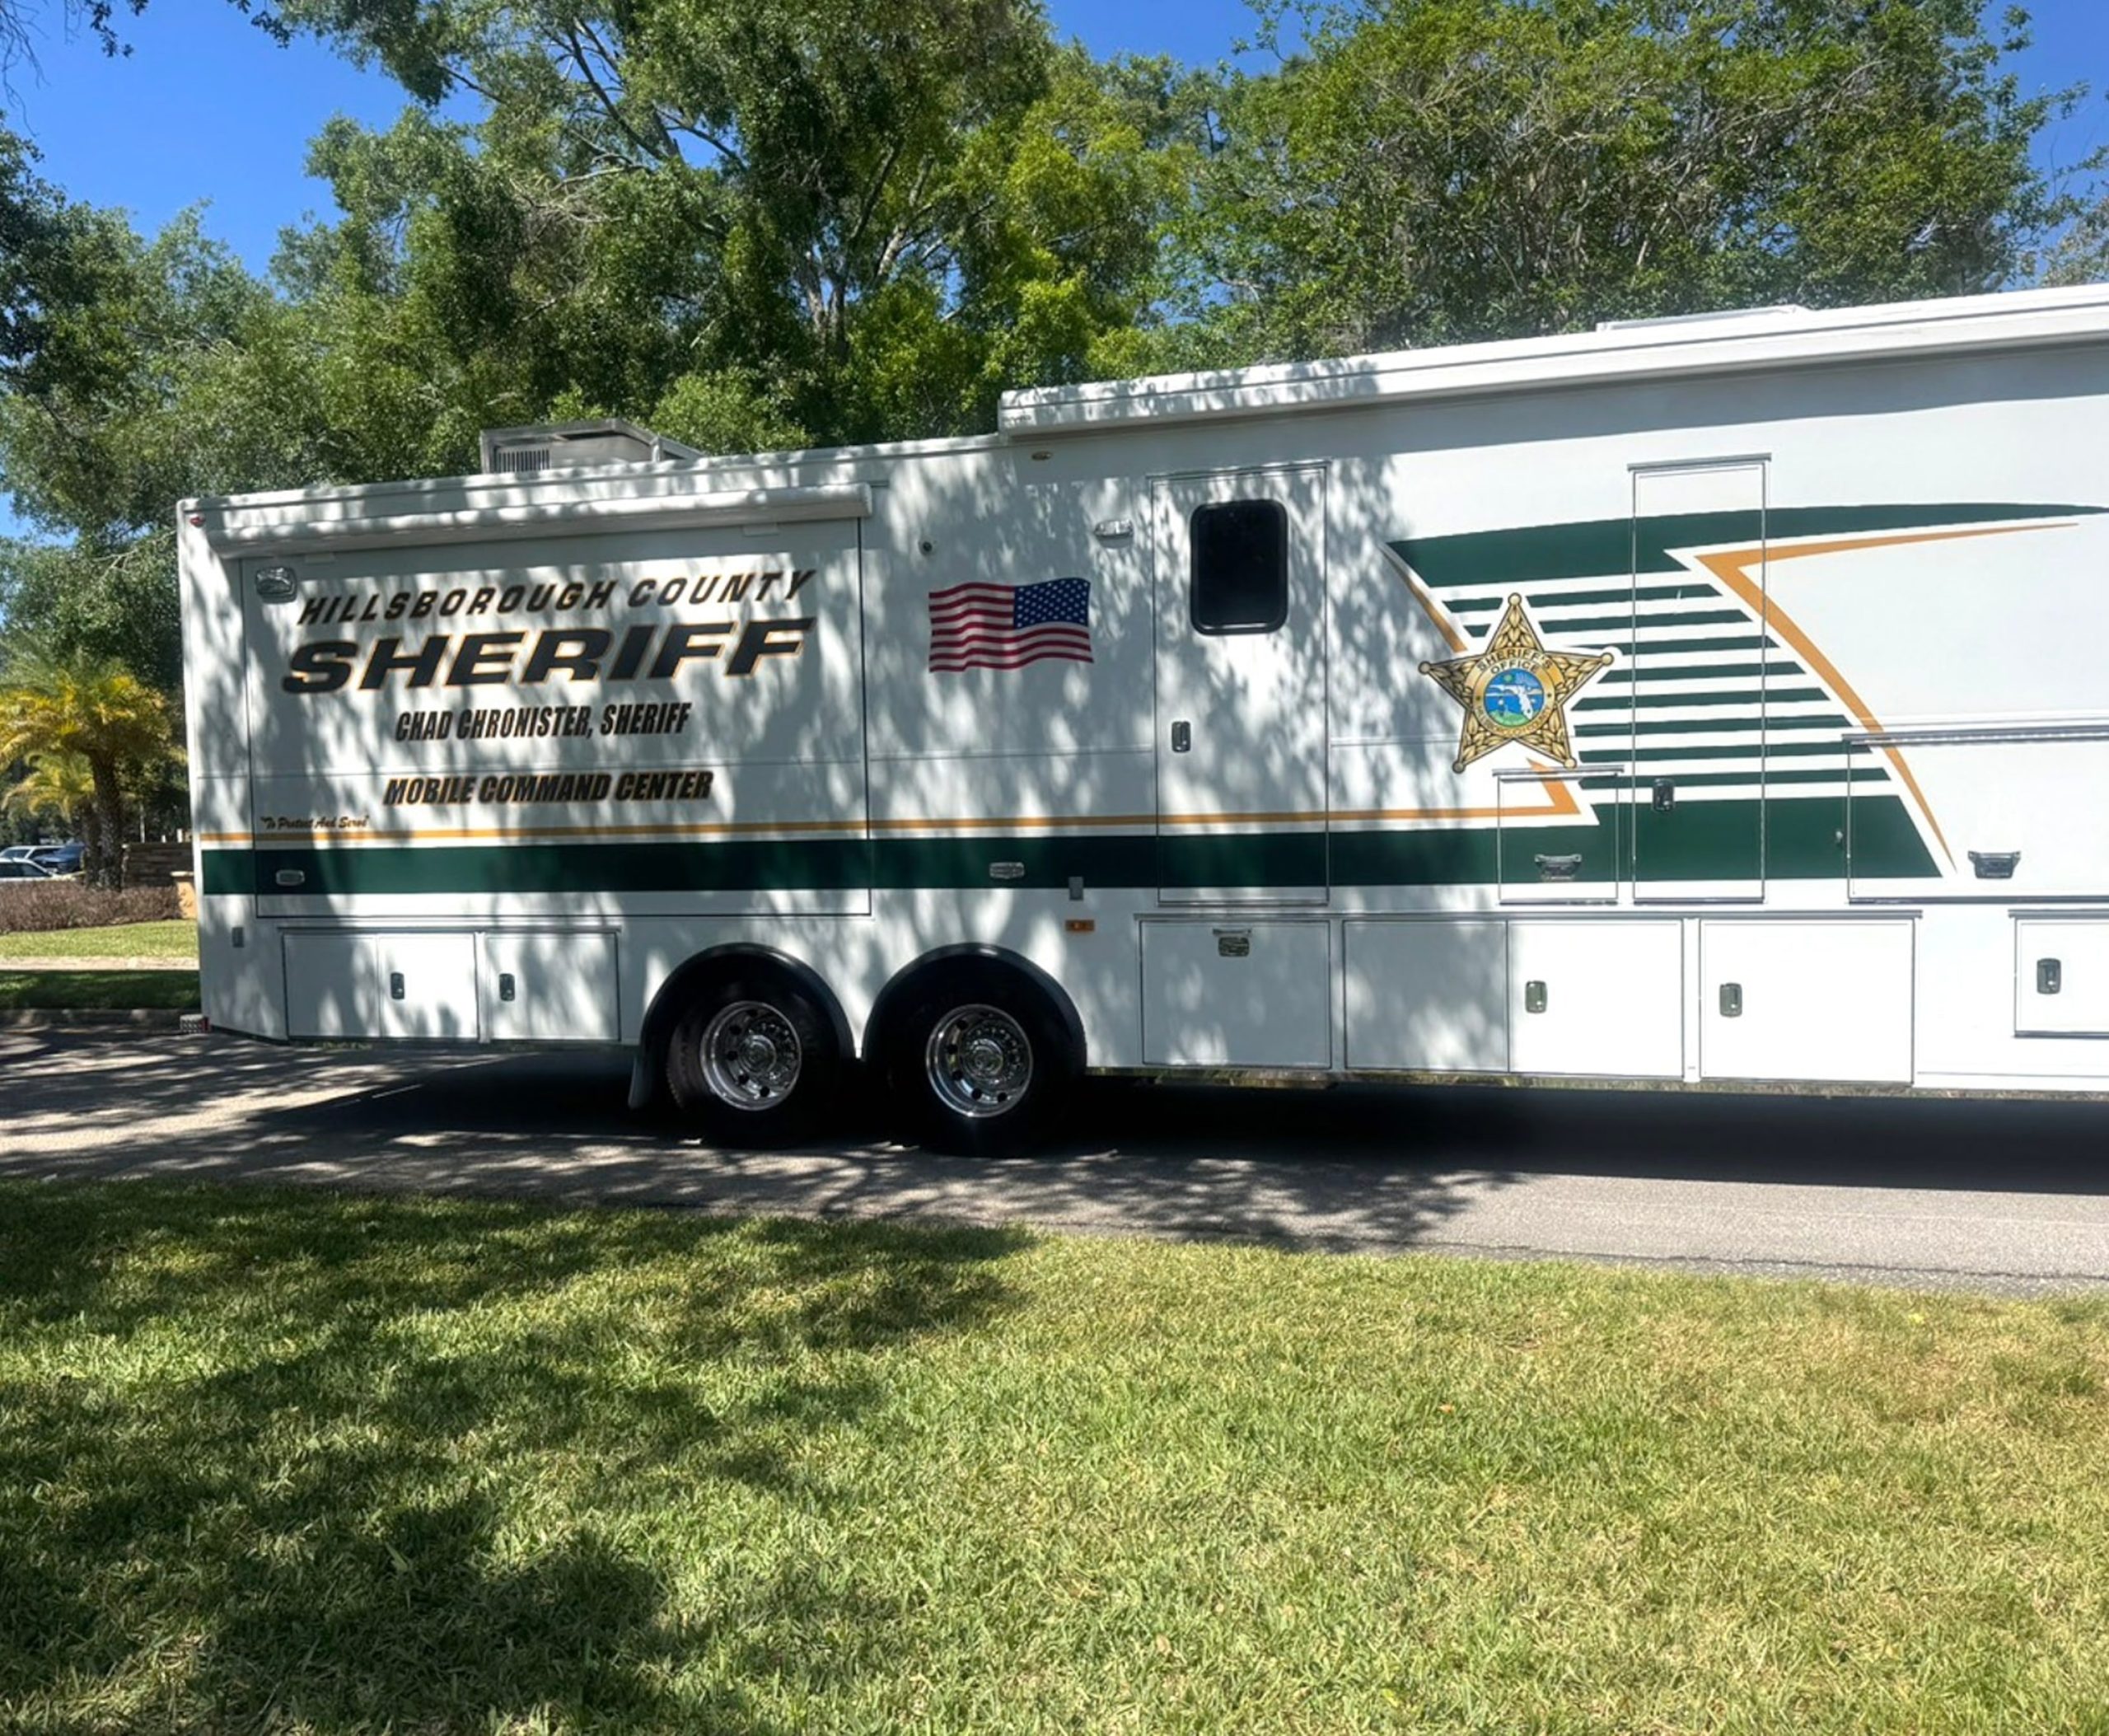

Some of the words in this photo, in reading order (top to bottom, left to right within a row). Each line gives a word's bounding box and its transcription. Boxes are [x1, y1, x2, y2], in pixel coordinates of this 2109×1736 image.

[297, 580, 617, 625] HILLSBOROUGH
[628, 569, 816, 607] COUNTY
[282, 617, 816, 694] SHERIFF
[1476, 648, 1553, 671] SHERIFF'S
[1490, 661, 1538, 674] OFFICE
[395, 711, 453, 741] CHAD
[456, 706, 593, 739] CHRONISTER,
[600, 703, 692, 737] SHERIFF
[383, 775, 476, 805] MOBILE
[478, 773, 610, 803] COMMAND
[615, 770, 714, 802] CENTER
